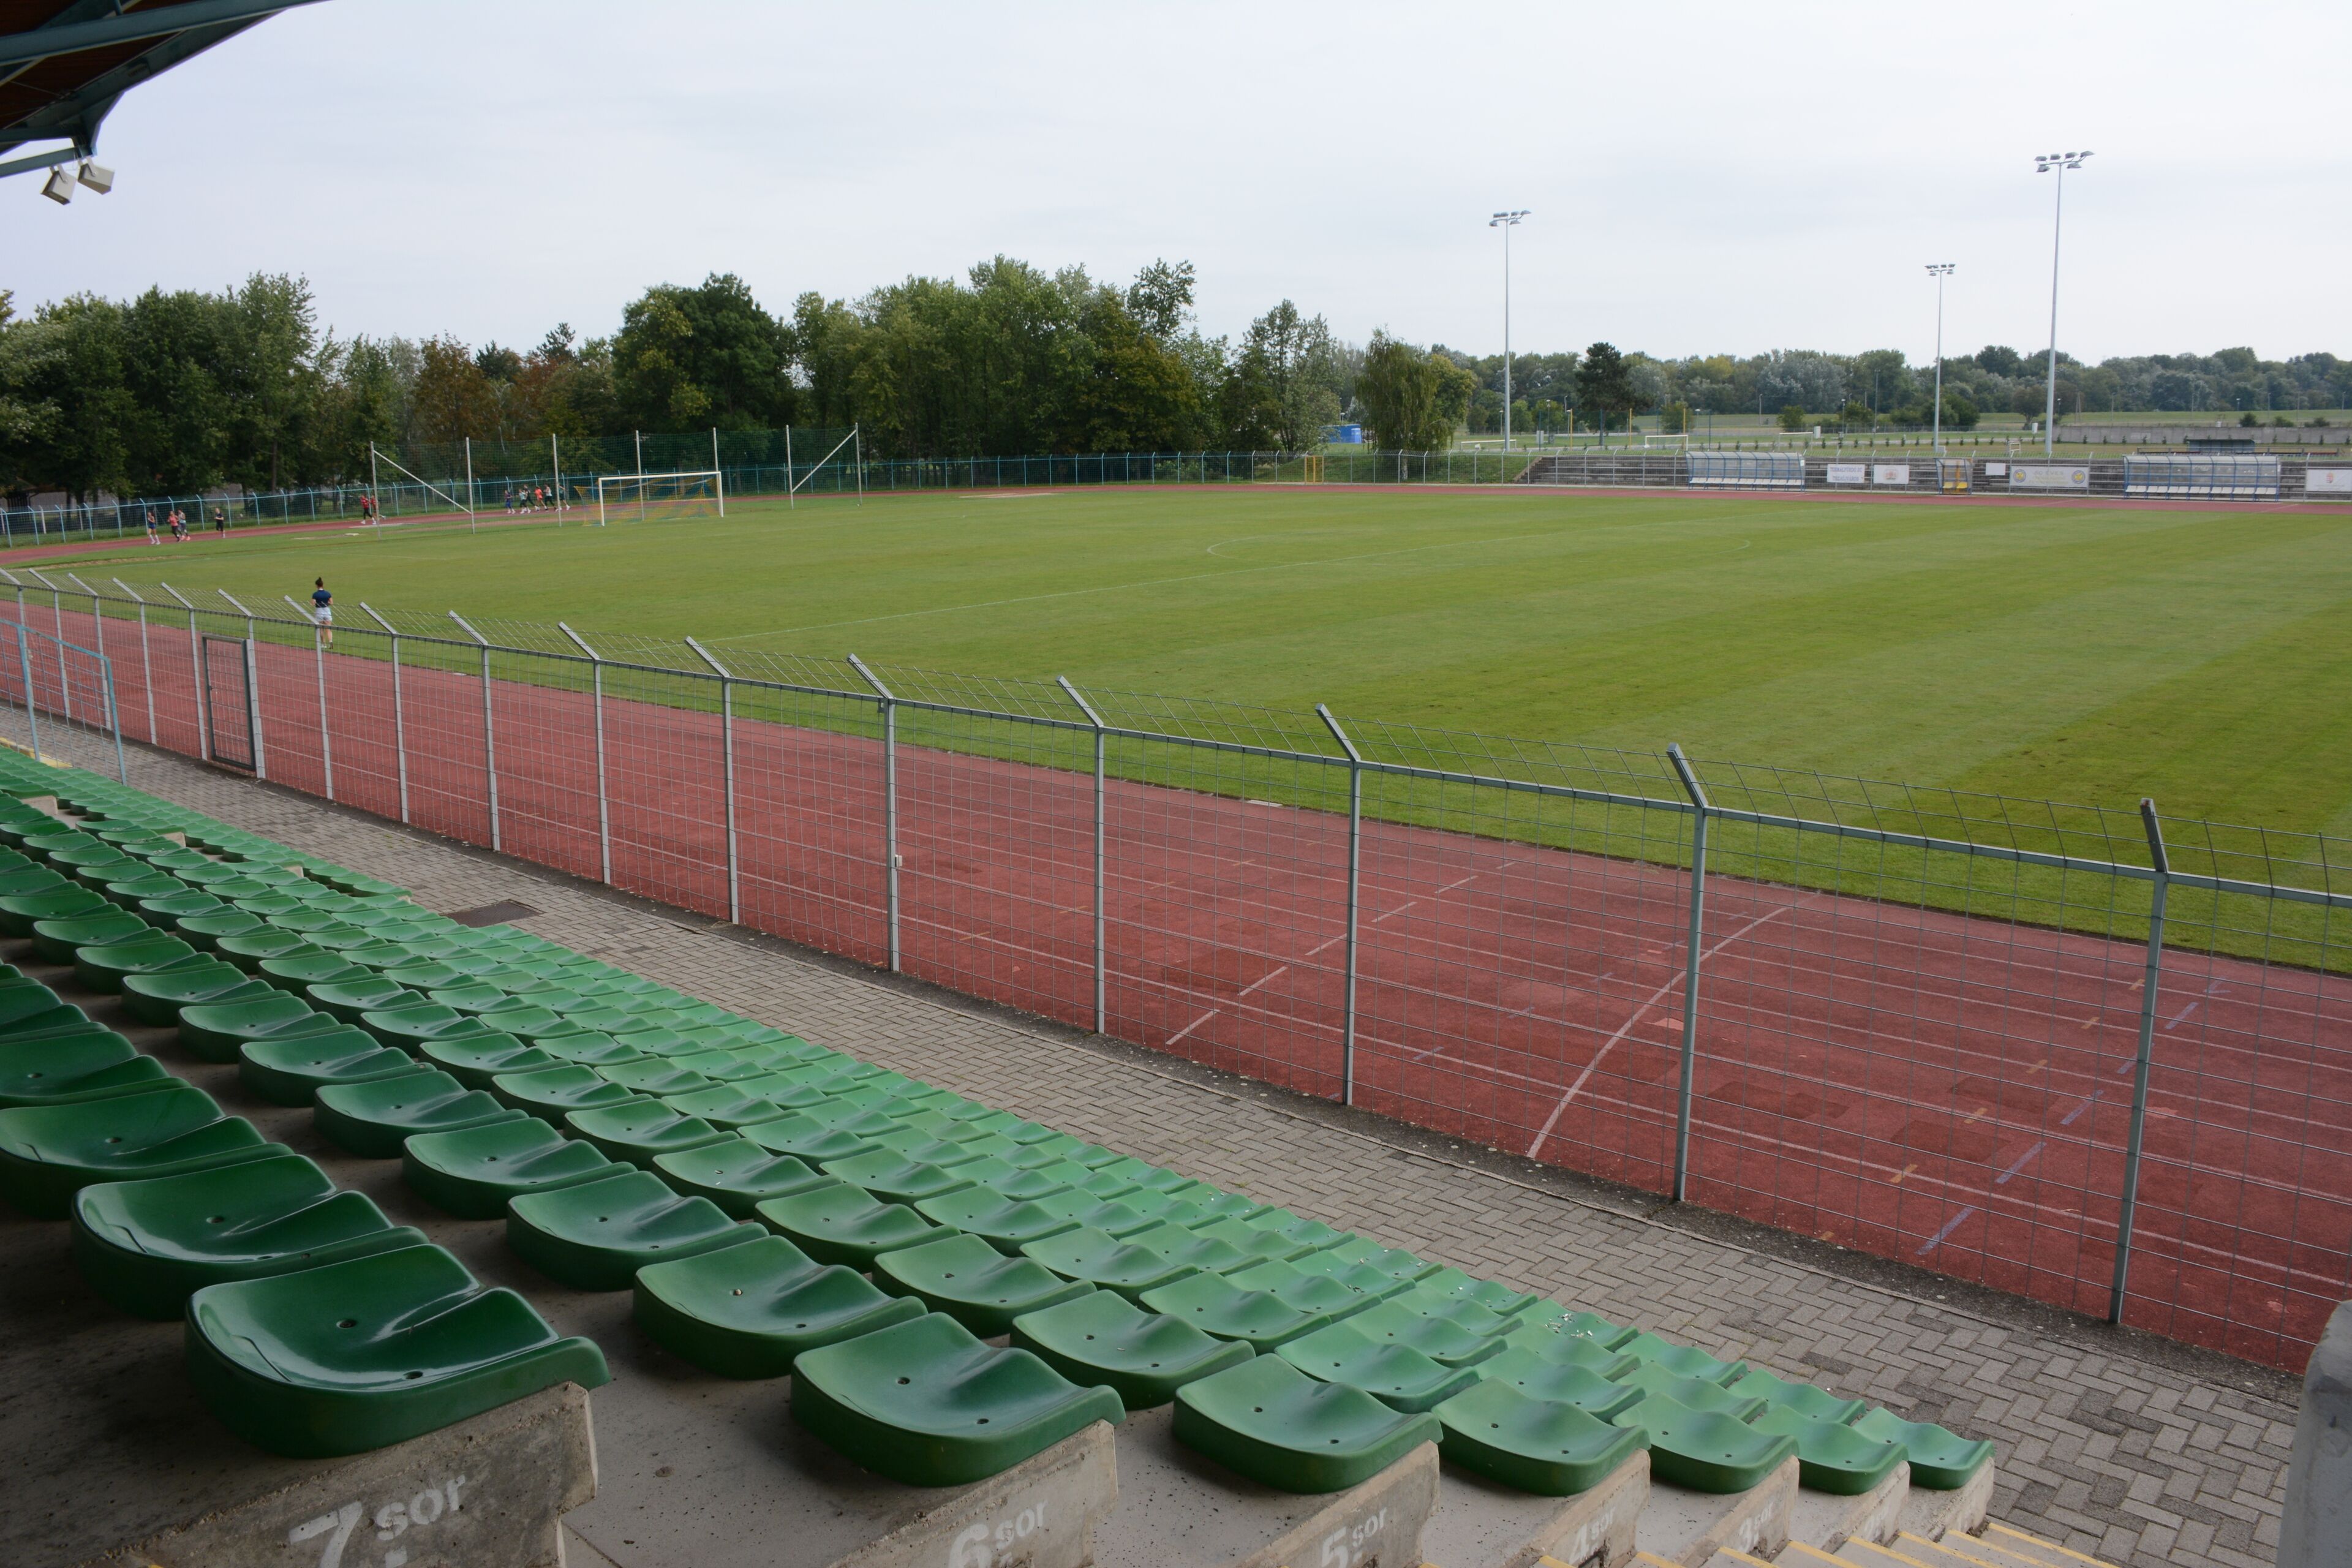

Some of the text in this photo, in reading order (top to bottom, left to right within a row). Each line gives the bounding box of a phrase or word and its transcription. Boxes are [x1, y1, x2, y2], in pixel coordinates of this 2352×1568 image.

[375, 1474, 466, 1540] sor
[995, 1499, 1049, 1551] sor
[1352, 1506, 1387, 1547] sor
[1591, 1506, 1616, 1540] sor
